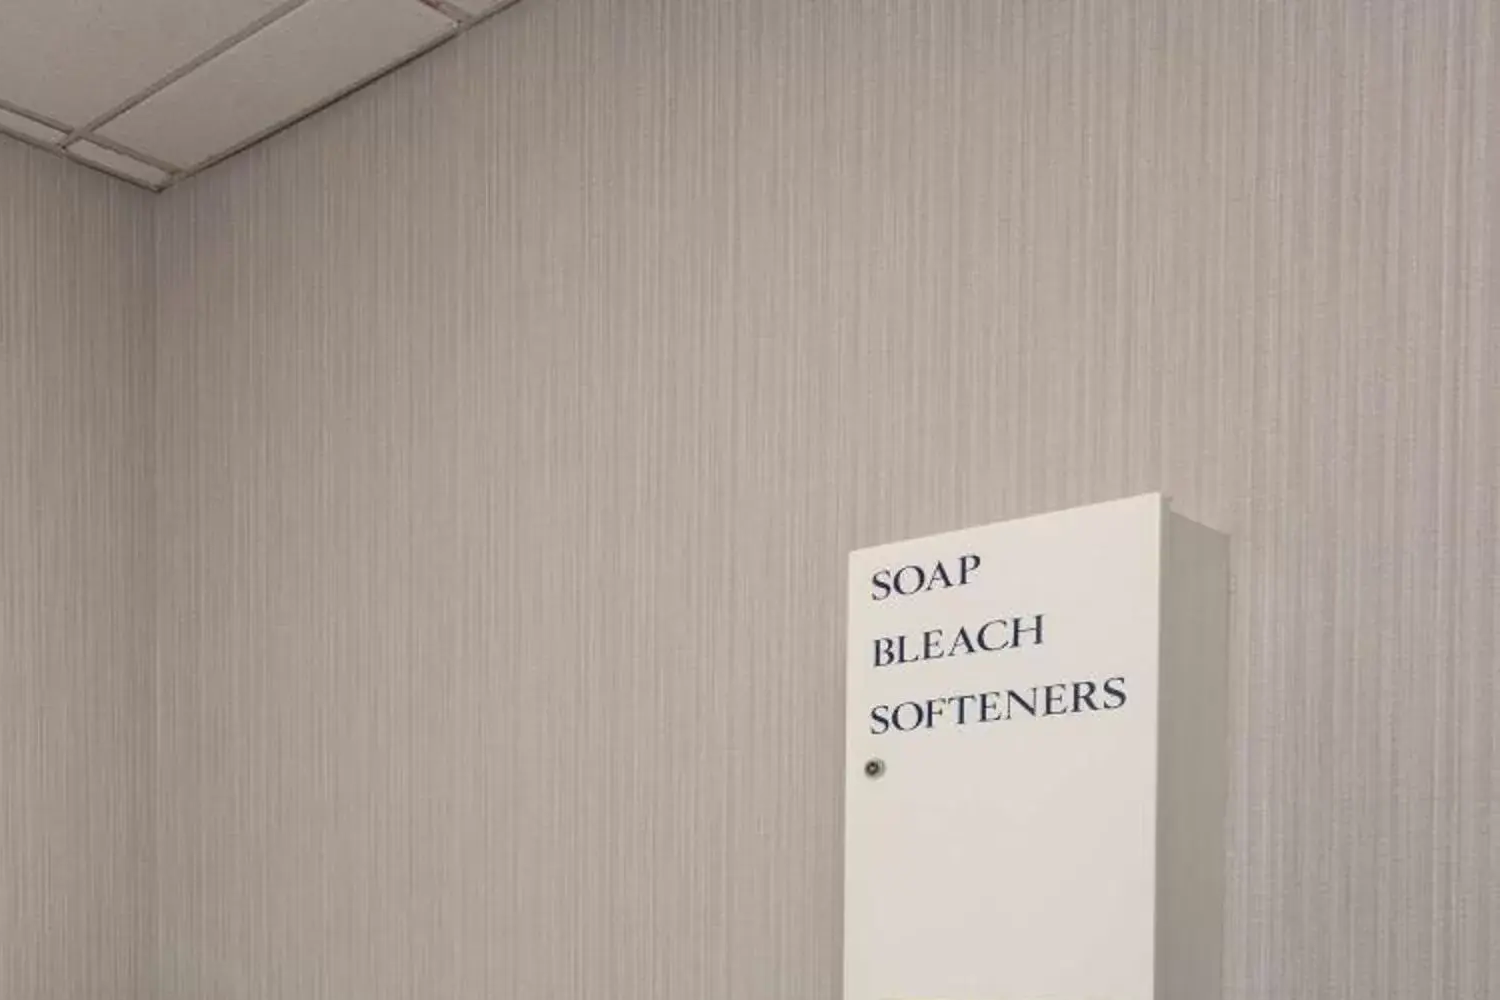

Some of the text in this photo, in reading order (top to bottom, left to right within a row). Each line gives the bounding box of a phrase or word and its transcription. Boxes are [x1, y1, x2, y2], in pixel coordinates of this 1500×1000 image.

[871, 554, 981, 601] SOAP
[873, 613, 1045, 668] BLEACH
[869, 676, 1128, 735] SOFTENERS
